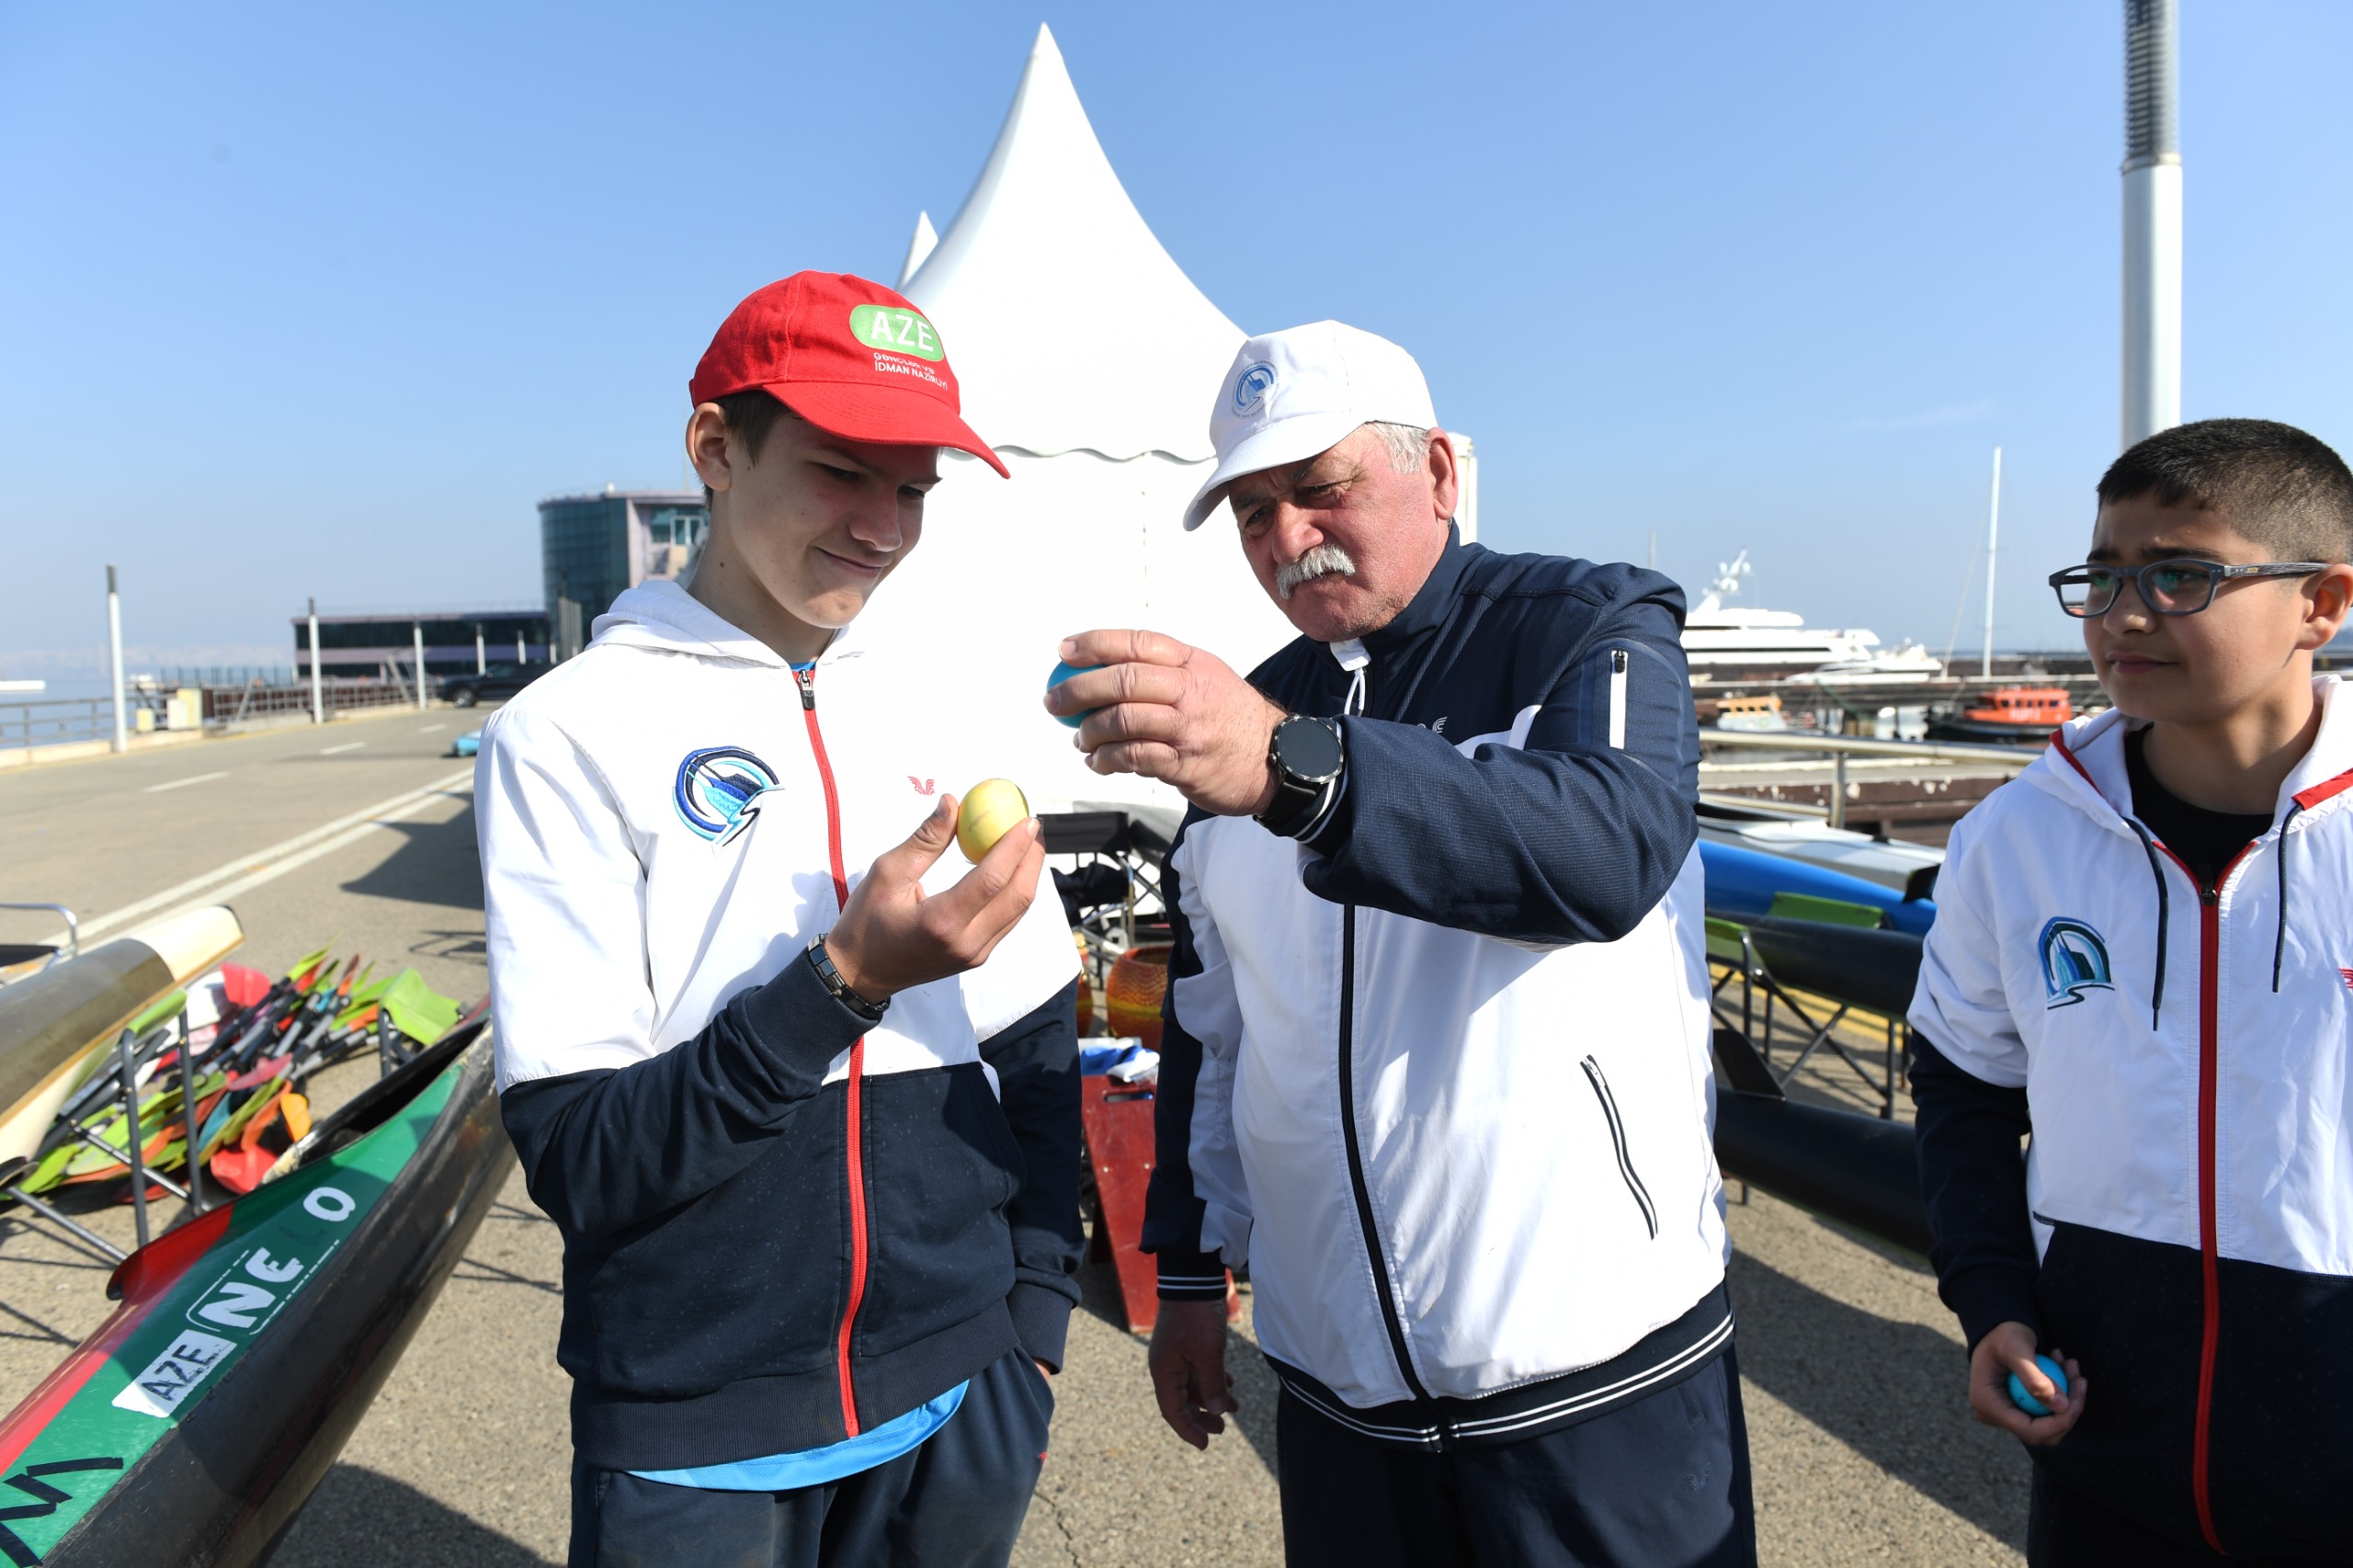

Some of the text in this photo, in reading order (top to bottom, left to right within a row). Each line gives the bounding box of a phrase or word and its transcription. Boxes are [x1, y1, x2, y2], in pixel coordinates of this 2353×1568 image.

[870, 311, 934, 353] AZE
[198, 1187, 356, 1328] NEO
[141, 1344, 219, 1402] AZE
